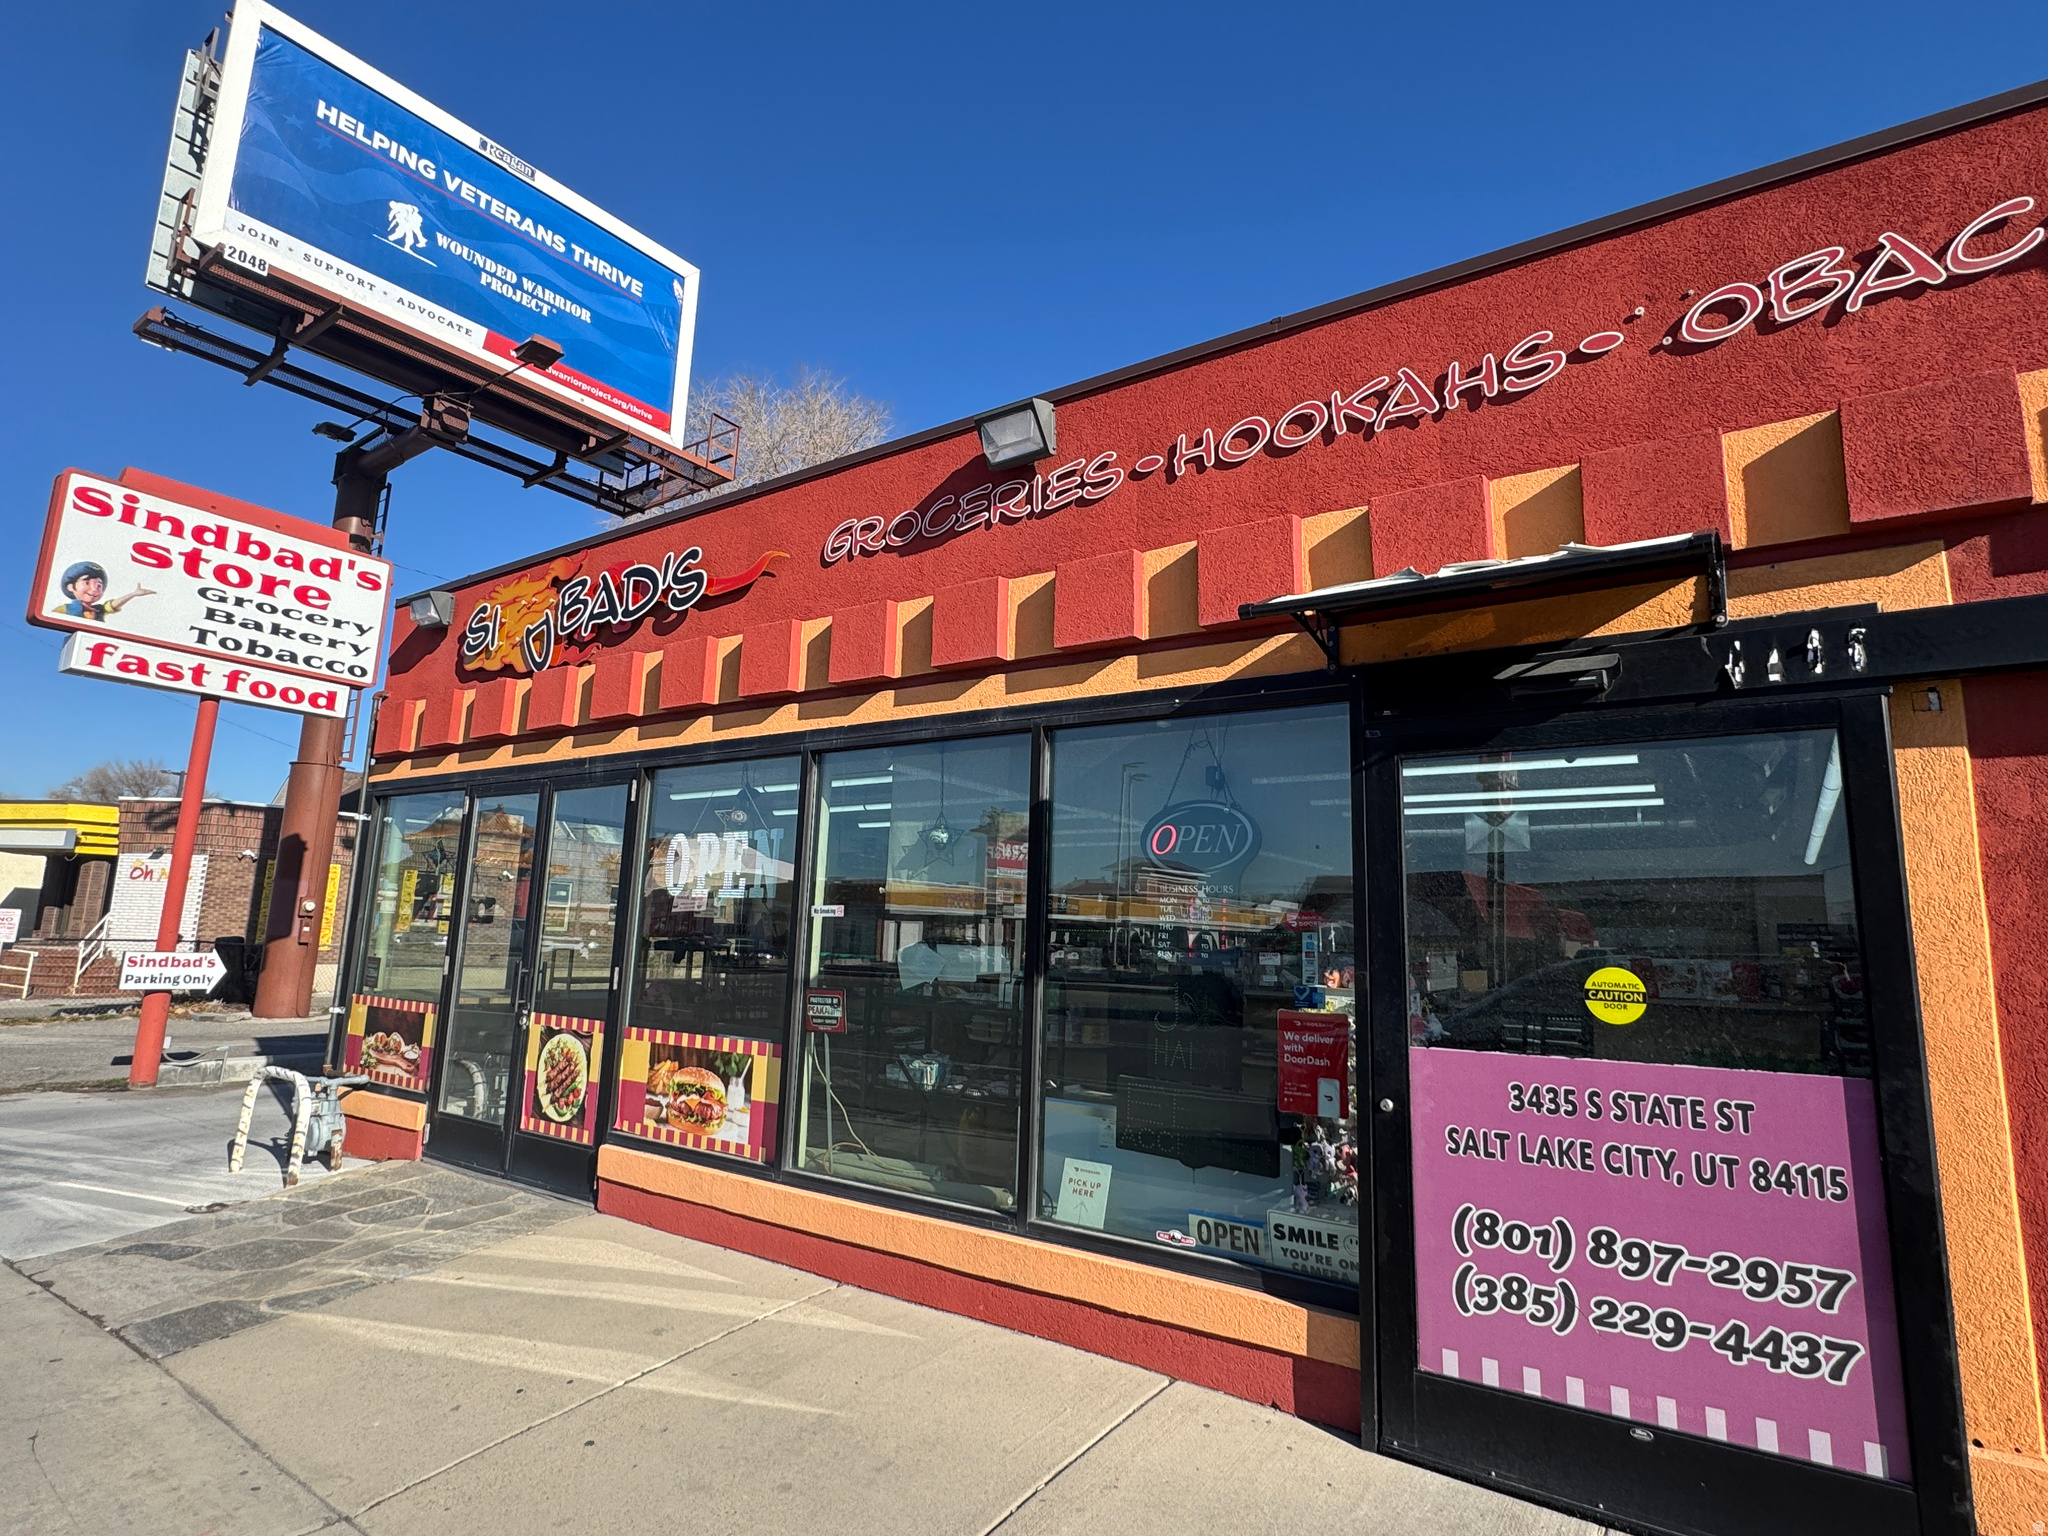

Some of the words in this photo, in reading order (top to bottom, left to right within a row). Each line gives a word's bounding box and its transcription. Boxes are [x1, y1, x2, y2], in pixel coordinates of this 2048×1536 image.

[485, 142, 533, 178] Reagan
[315, 99, 437, 181] HELPING
[443, 170, 568, 253] VETERANS
[570, 246, 644, 298] THRIVE
[227, 245, 267, 272] 2048
[237, 223, 280, 248] JOIN
[303, 252, 376, 293] SUPPORT
[396, 295, 474, 338] ADVOCATE
[435, 231, 518, 281] WOUNDED
[522, 275, 592, 325] WARRIOR
[822, 451, 1125, 564] GROCERIES
[1174, 329, 1566, 477] HOOKAHS
[72, 485, 382, 592] Sindbad's
[197, 587, 375, 637] Grocery
[204, 606, 372, 657] Bakery
[189, 625, 368, 678] Tobacco
[86, 642, 210, 688] fast
[223, 669, 337, 712] food
[1151, 823, 1242, 855] OPEN
[665, 828, 784, 898] OPEN
[1160, 885, 1198, 893] BUSINESS
[1202, 885, 1234, 893] HOURS
[820, 907, 837, 916] Smoking
[126, 954, 217, 969] Sindbad's
[124, 973, 181, 987] Parking
[183, 972, 215, 987] Only
[1588, 990, 1643, 1002] CAUTION
[1591, 980, 1640, 990] AUTOMATIC
[1283, 1031, 1300, 1040] We
[1302, 1033, 1334, 1044] deliver
[1284, 1044, 1304, 1053] with
[1284, 1054, 1330, 1067] DoorDash
[1508, 1081, 1578, 1118] 3435
[1586, 1089, 1603, 1121] S
[1611, 1091, 1707, 1130] STATE
[1715, 1101, 1755, 1135] ST
[1445, 1126, 1511, 1161] SALT
[1519, 1134, 1595, 1173] LAKE
[1602, 1142, 1685, 1187] CITY,
[1693, 1152, 1740, 1188] UT
[1750, 1160, 1849, 1202] 84115
[1068, 1177, 1087, 1187] PICK
[1072, 1188, 1094, 1198] HERE
[1197, 1218, 1260, 1256] OPEN
[1273, 1222, 1339, 1250] SMILE
[1280, 1247, 1332, 1267] YOU'RE
[1339, 1259, 1359, 1272] ON
[1291, 1262, 1350, 1283] CAMERA
[1452, 1203, 1575, 1272] (801)
[1586, 1226, 1856, 1314] 897-2957
[1452, 1263, 1579, 1335] (385)
[1589, 1296, 1865, 1385] 229-4437
